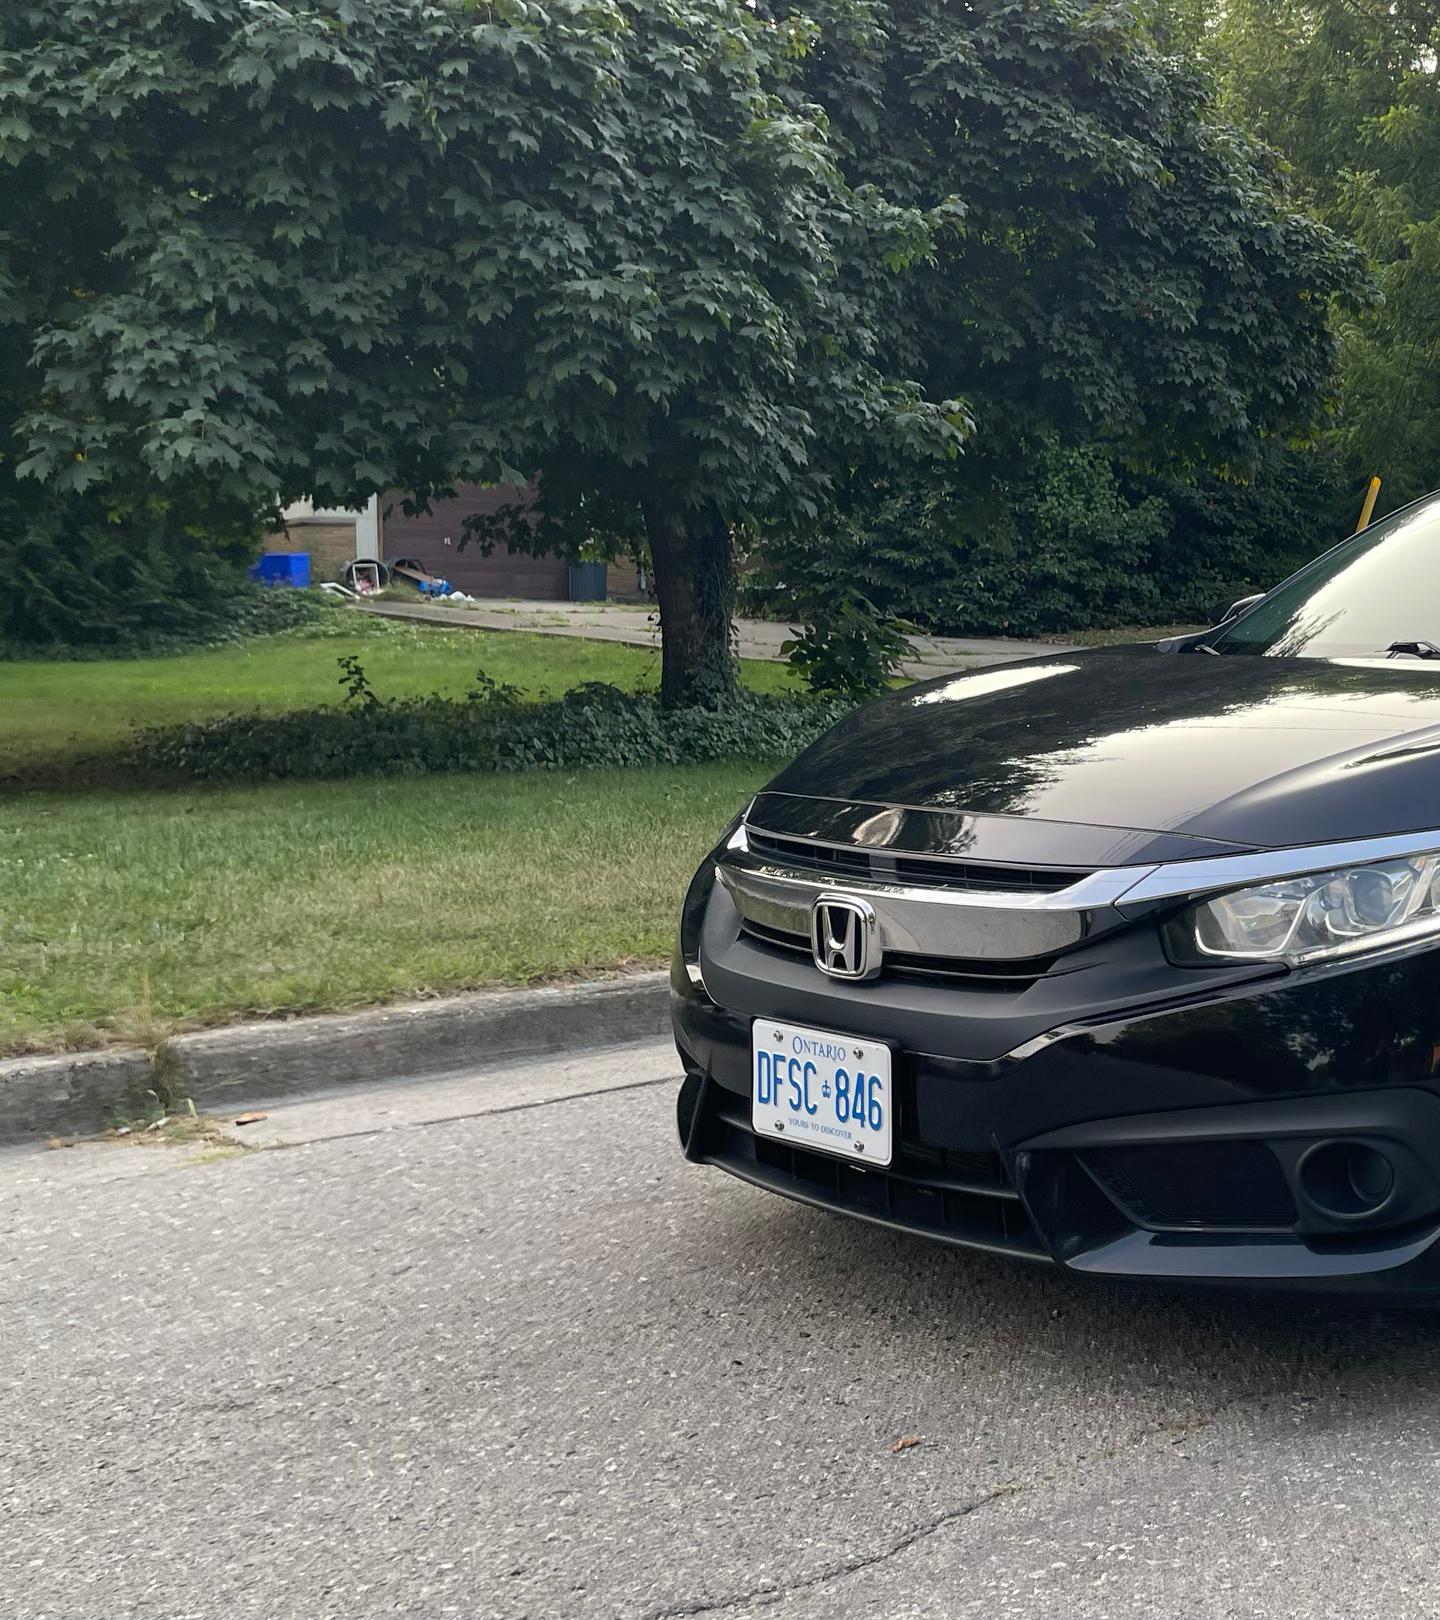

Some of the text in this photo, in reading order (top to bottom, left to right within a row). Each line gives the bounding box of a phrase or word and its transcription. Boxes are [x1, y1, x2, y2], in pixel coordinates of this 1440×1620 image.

[792, 1036, 846, 1062] ONTARIO
[758, 1050, 883, 1131] DFSC 846
[788, 1118, 852, 1139] YOURS TO DISCOVER
